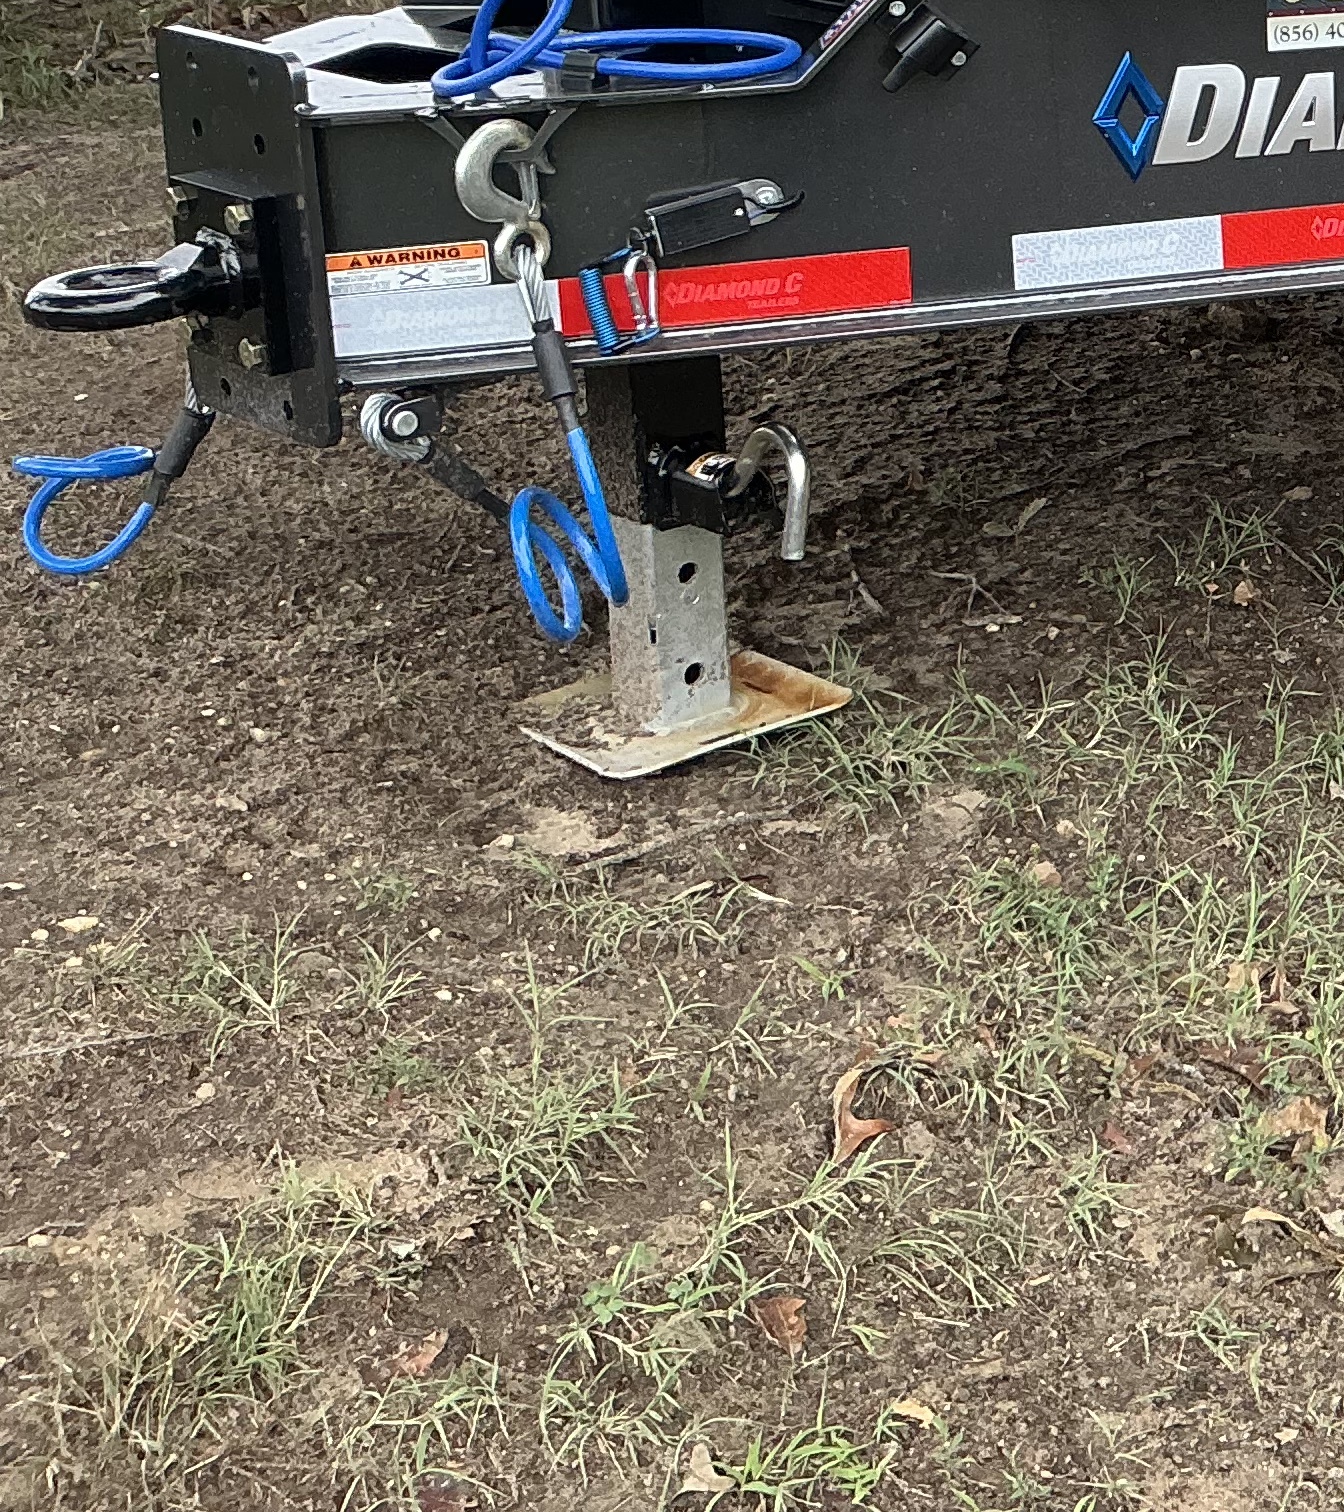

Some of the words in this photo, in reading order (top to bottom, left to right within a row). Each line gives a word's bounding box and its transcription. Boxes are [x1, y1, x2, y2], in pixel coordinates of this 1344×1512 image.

[1273, 22, 1319, 45] (856)
[366, 247, 461, 266] WARNING
[677, 277, 781, 304] DIAMOND
[785, 271, 805, 295] C
